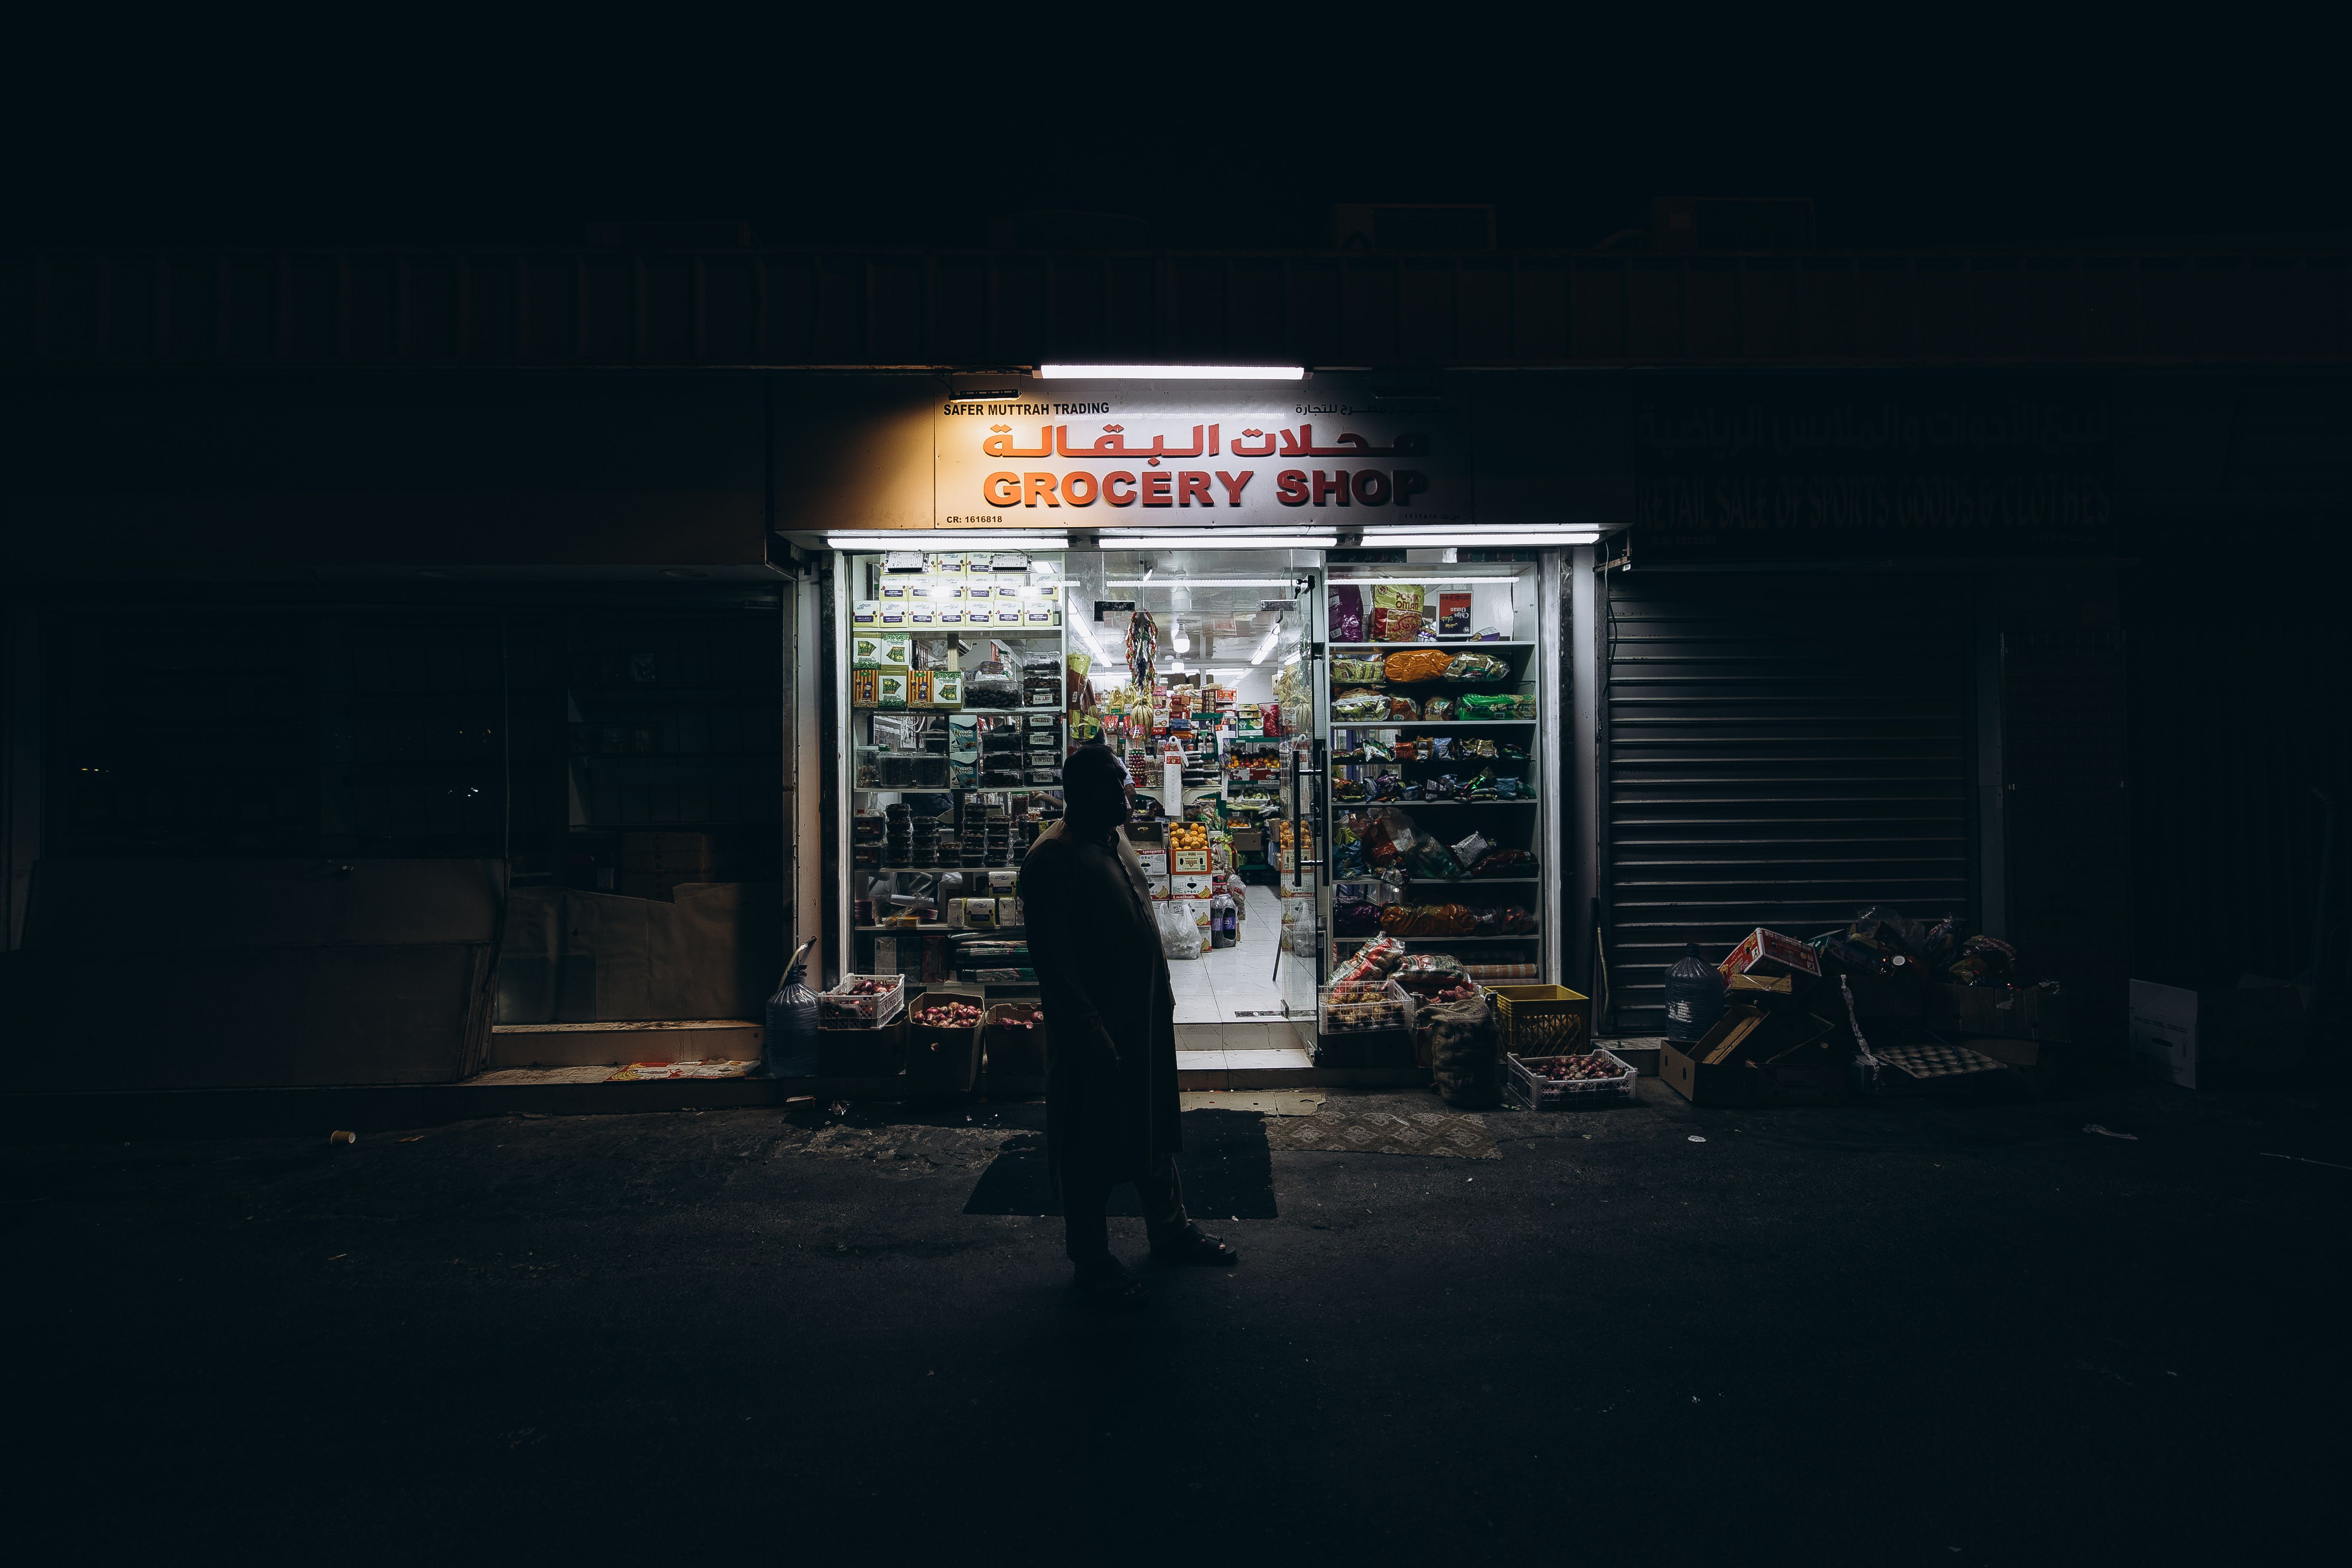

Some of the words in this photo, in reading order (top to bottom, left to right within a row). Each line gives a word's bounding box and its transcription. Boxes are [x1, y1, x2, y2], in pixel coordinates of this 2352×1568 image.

[943, 404, 984, 416] SAFER
[988, 403, 1049, 415] MUTTRAH
[1053, 402, 1110, 414] TRADING
[1295, 404, 1338, 416] للتجارة
[983, 423, 1220, 467] البقالة
[1231, 423, 1429, 458] محلات
[983, 470, 1254, 508] GROCERY
[1276, 469, 1430, 508] SHOP
[1636, 474, 1713, 530] RETAIL
[1715, 474, 1769, 530] SALE
[1775, 474, 1803, 530] OF
[1806, 474, 1891, 530] SPORTS
[1896, 474, 1975, 529] GOODS
[2001, 473, 2111, 528] CLOTHES
[1675, 536, 1716, 545] 1072803
[1396, 592, 1419, 602] POFAK
[1395, 600, 1419, 610] OMAN
